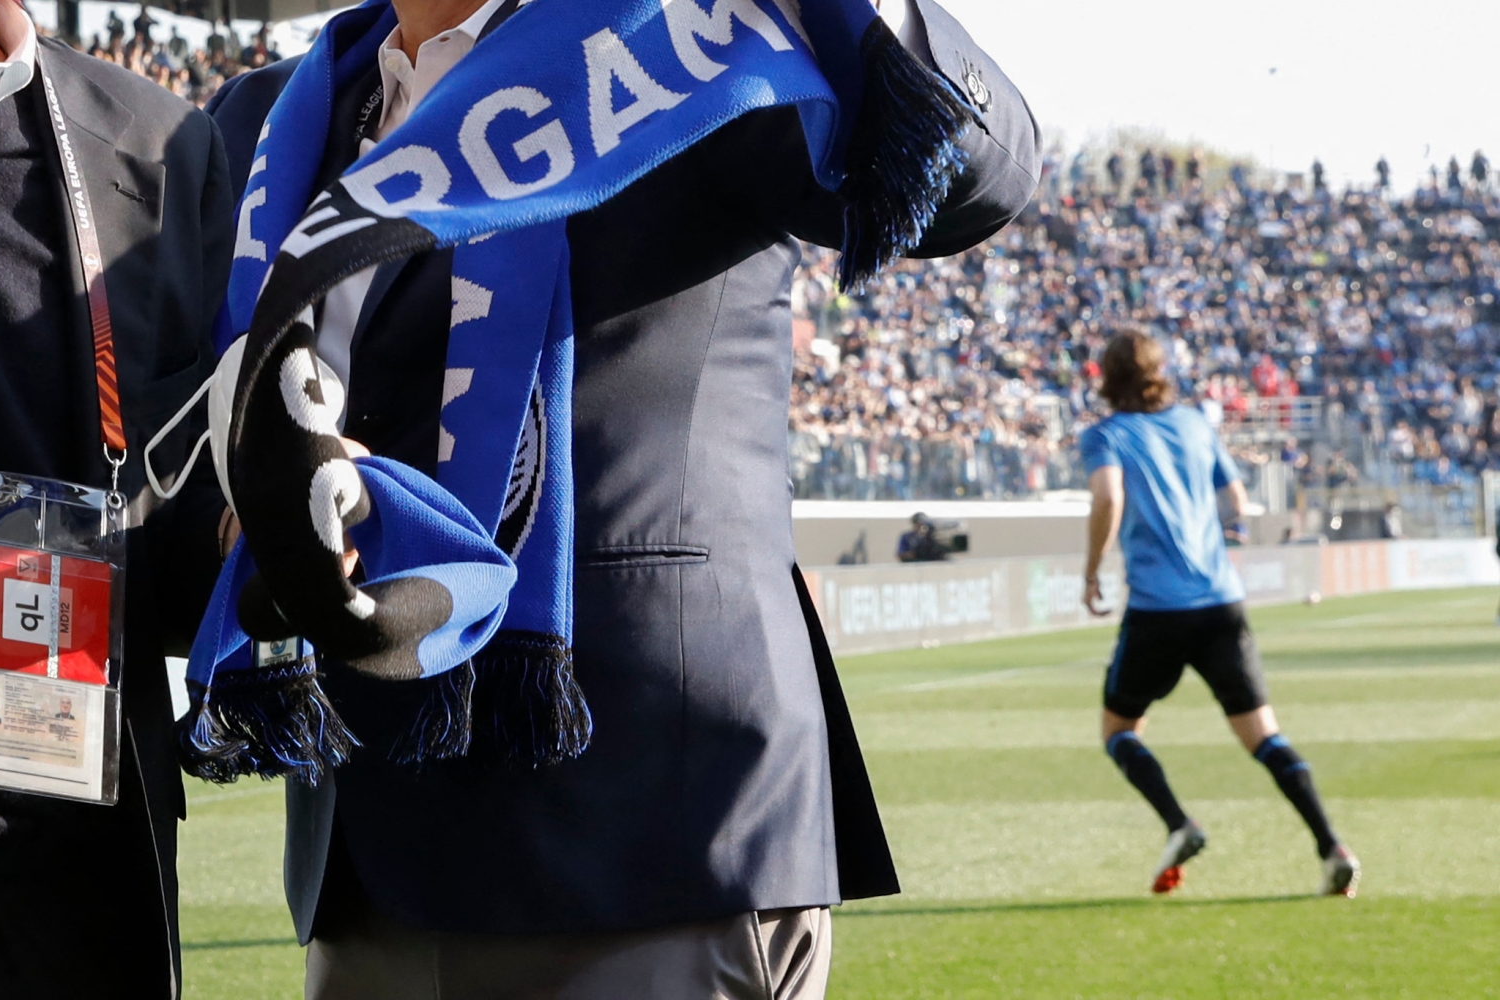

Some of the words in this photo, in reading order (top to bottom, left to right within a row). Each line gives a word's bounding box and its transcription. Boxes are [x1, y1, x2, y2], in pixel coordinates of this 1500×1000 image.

[44, 76, 67, 130] LEAGUE
[60, 133, 81, 188] EUROPA
[74, 190, 90, 229] UEFA
[59, 602, 71, 634] MD12
